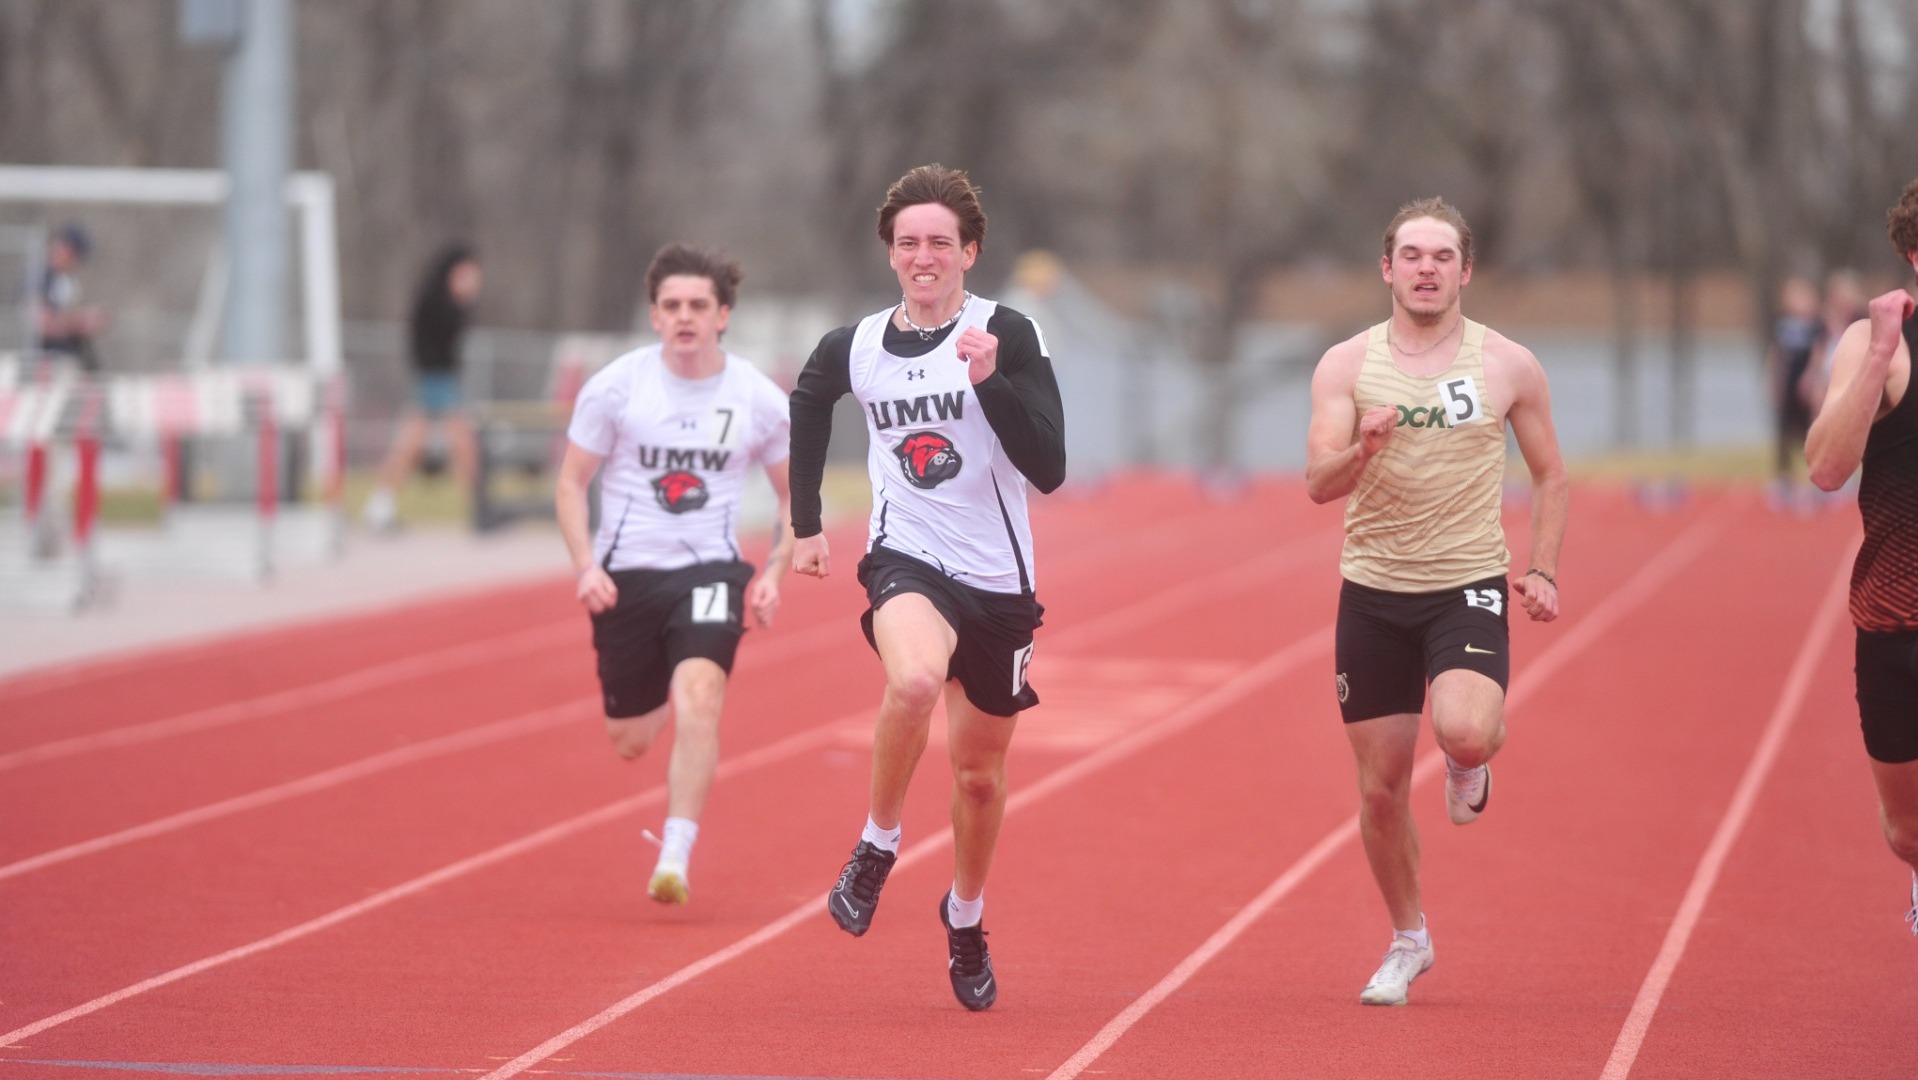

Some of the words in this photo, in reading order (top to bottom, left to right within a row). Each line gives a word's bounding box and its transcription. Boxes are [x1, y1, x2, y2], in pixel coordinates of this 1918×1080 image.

[868, 390, 965, 431] UMW
[1447, 379, 1474, 421] 5
[716, 409, 733, 444] 7
[639, 446, 731, 472] UMW
[701, 582, 718, 616] 7
